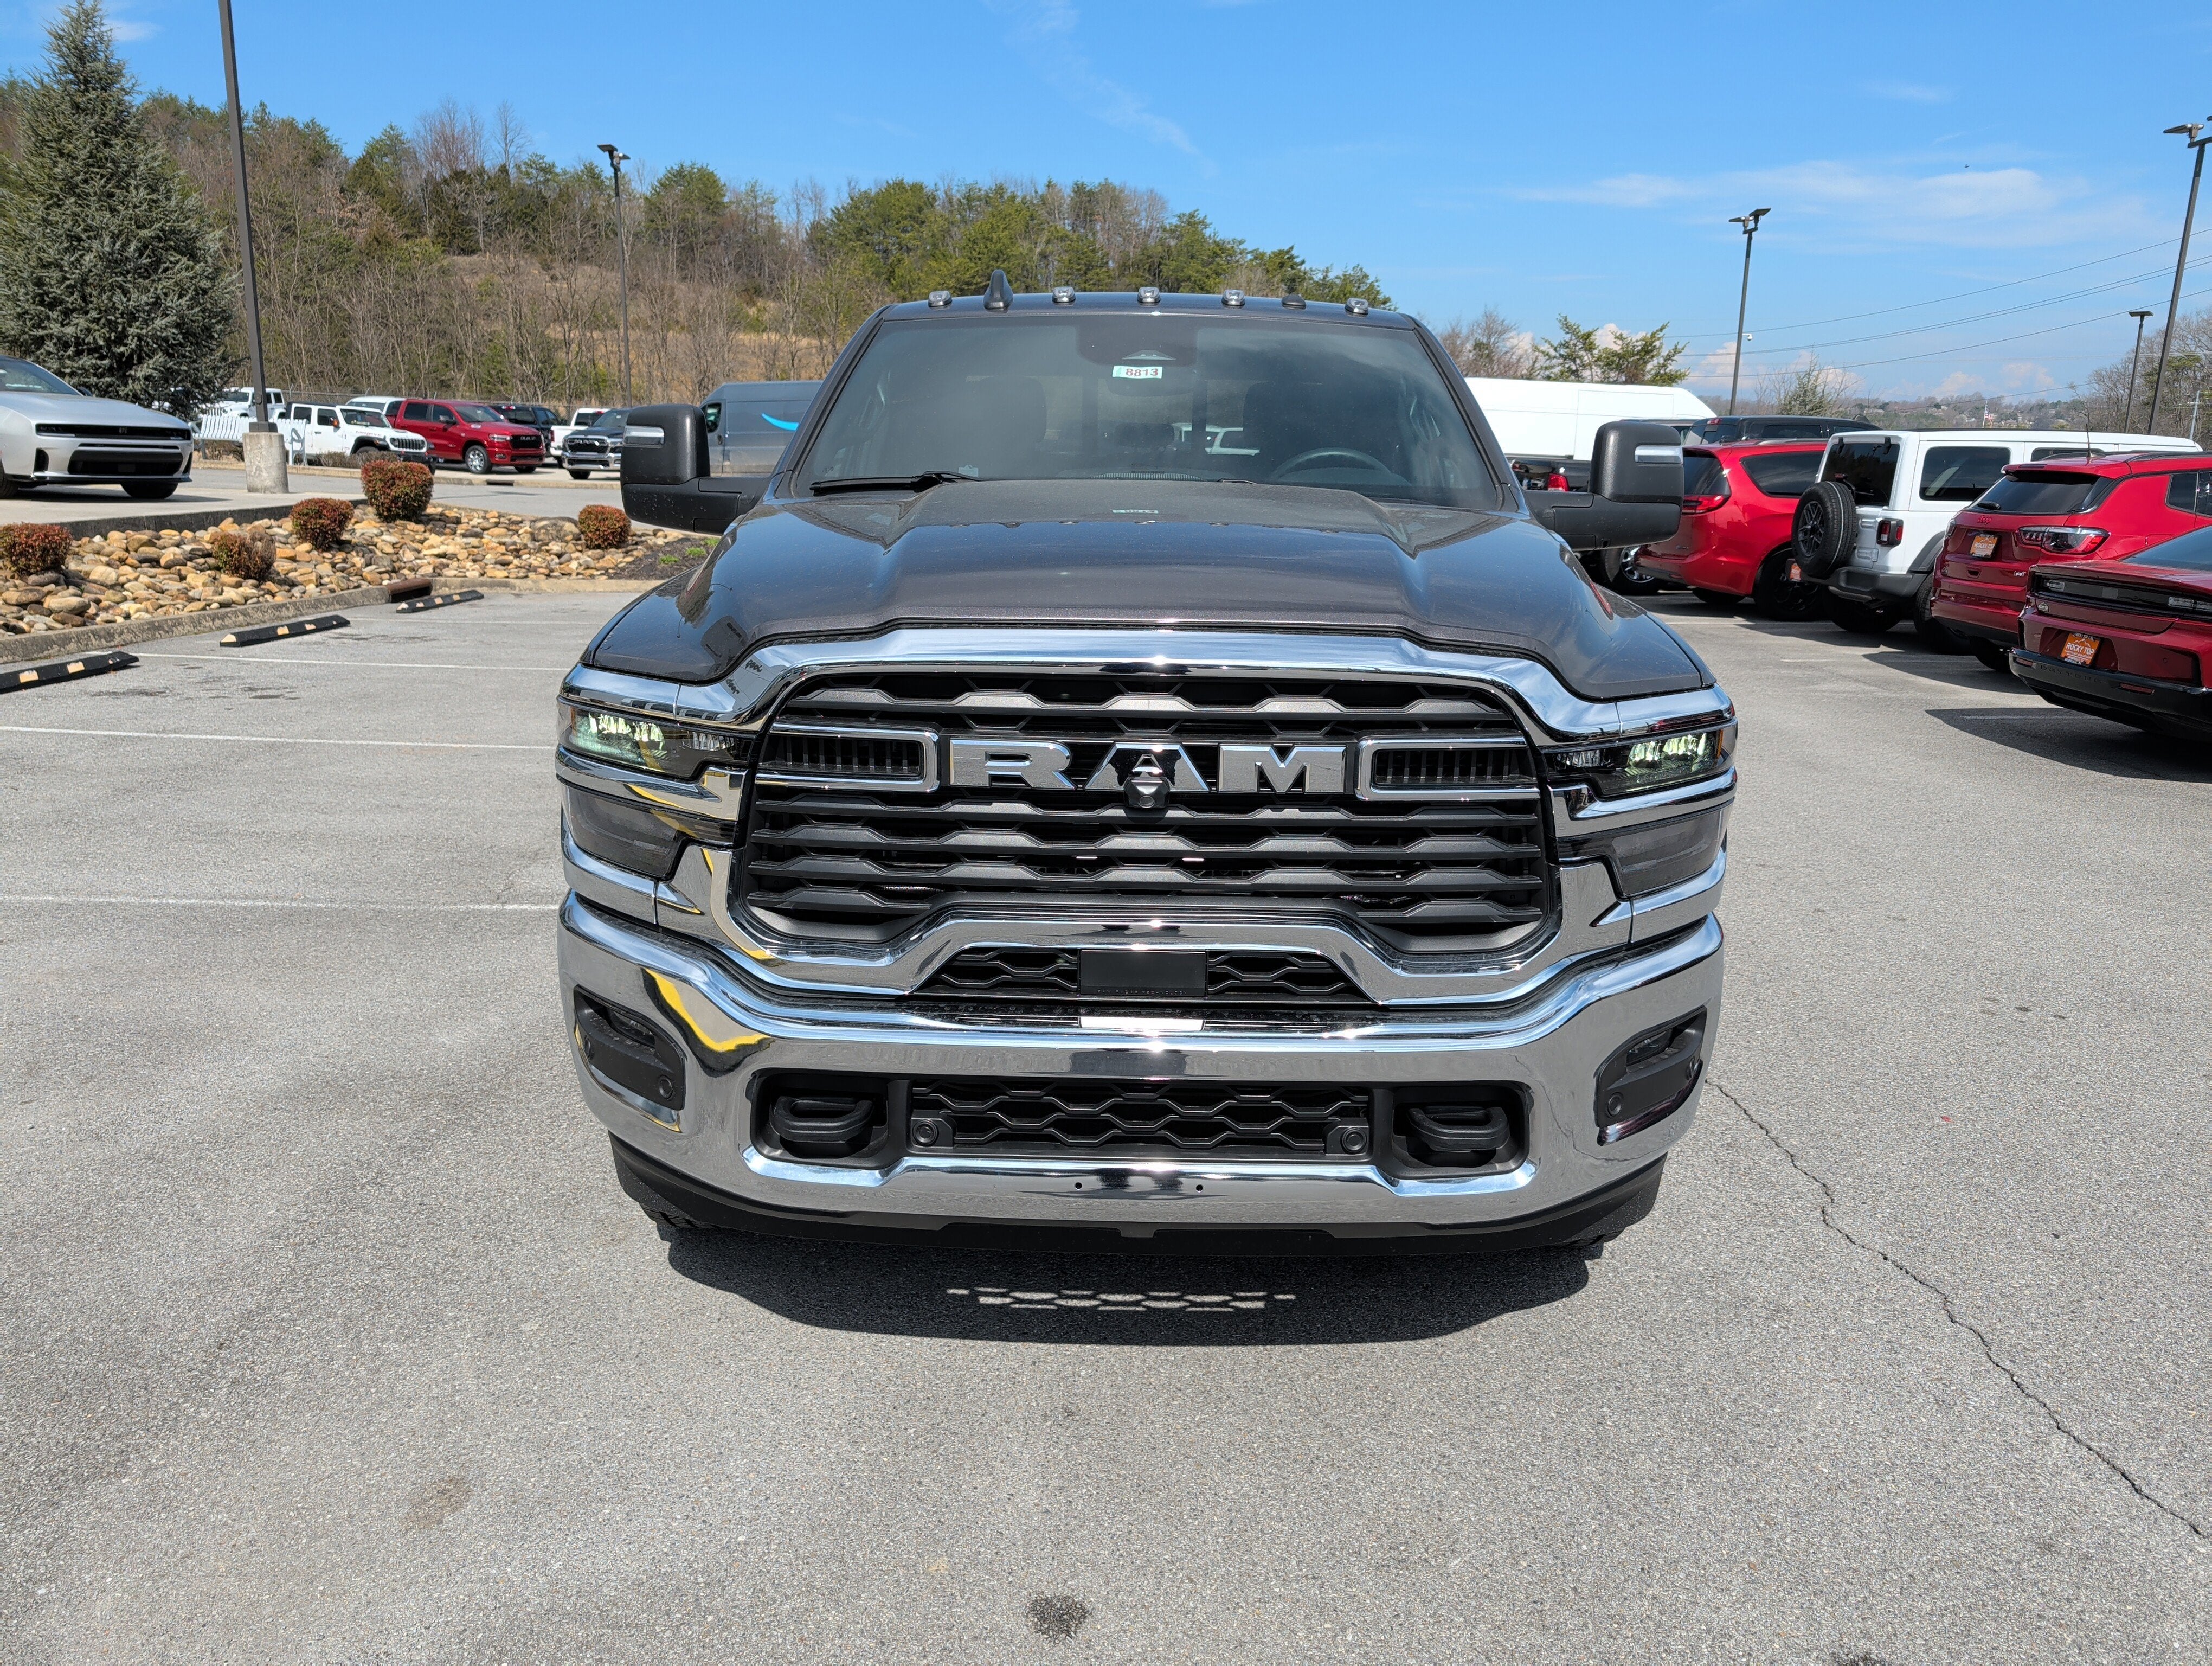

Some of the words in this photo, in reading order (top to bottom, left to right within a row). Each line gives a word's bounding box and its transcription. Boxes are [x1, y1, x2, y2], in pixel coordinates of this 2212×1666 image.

[1125, 368, 1159, 376] 8813
[2066, 642, 2084, 652] ROCKY
[2084, 647, 2094, 655] TOP
[949, 739, 1347, 793] RAM
